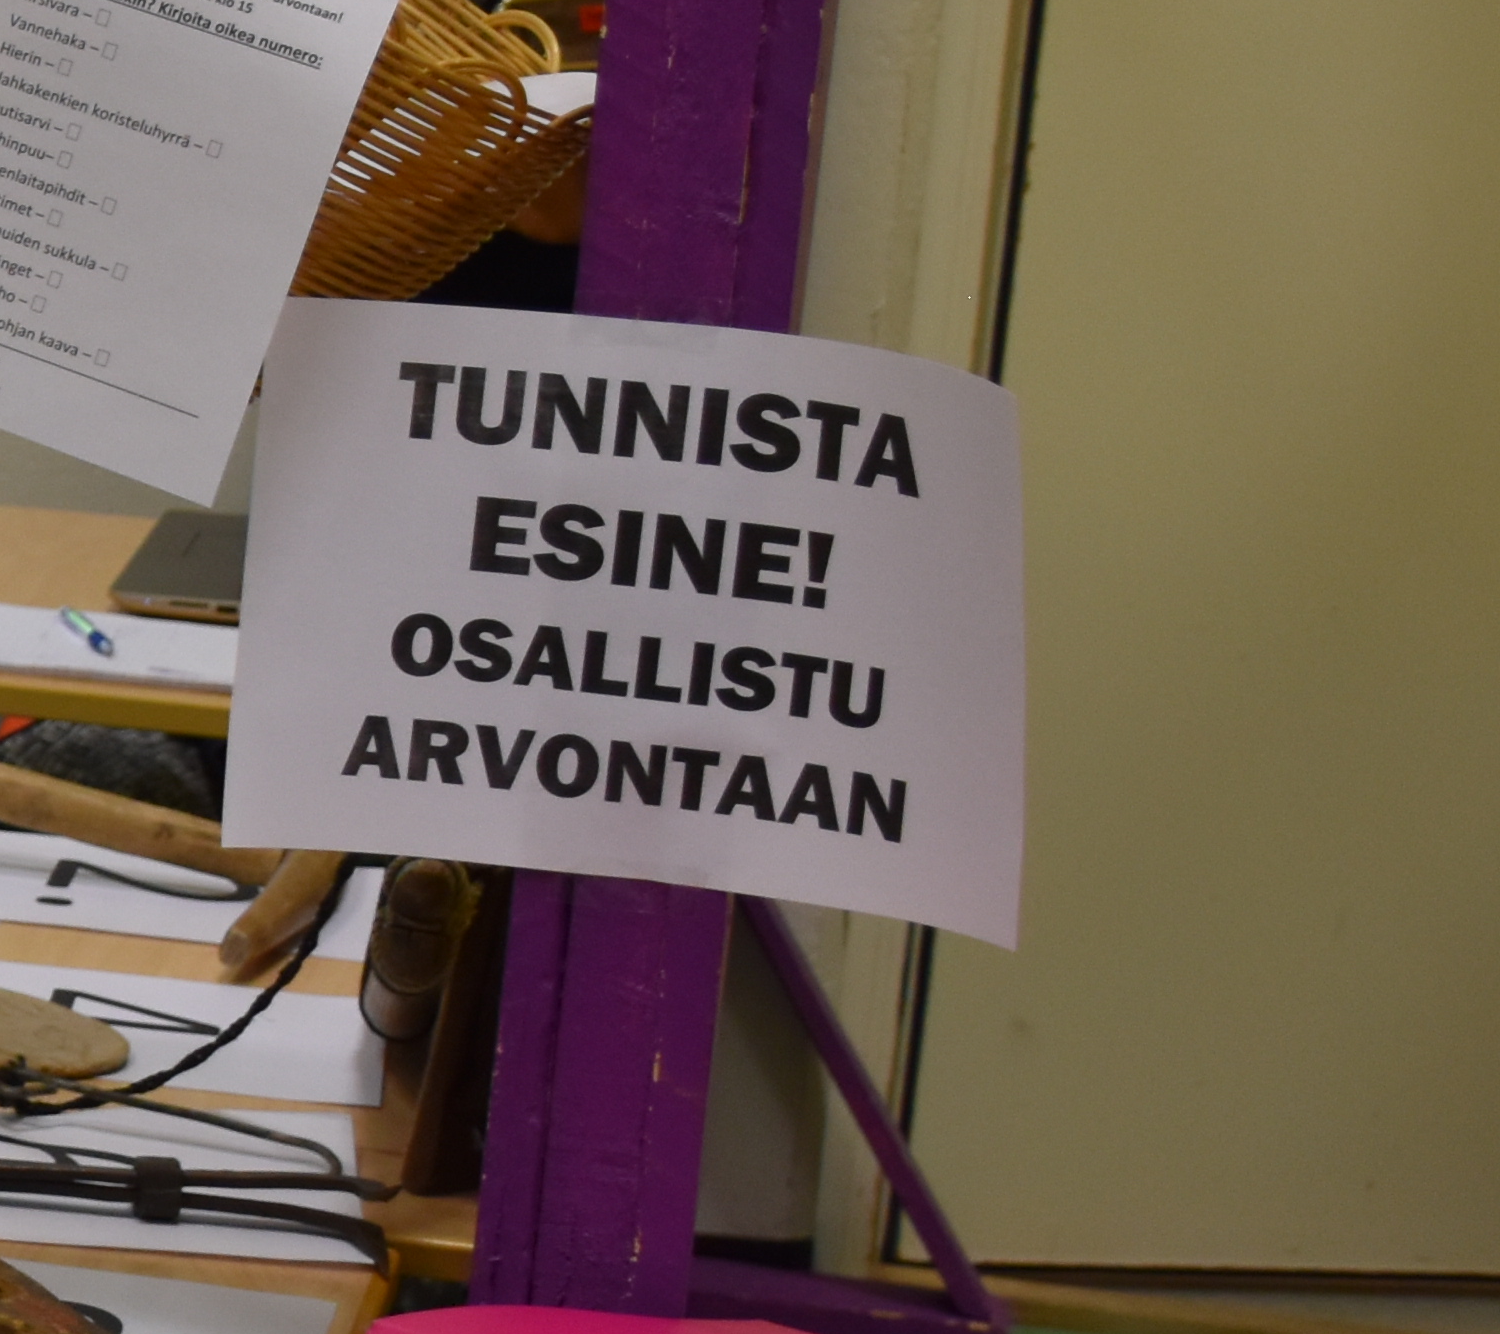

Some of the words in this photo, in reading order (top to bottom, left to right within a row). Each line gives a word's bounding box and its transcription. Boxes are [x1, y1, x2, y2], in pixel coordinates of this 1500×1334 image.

[10, 13, 86, 50] Vannehaka
[238, 0, 254, 14] 15
[0, 41, 42, 67] Hierin
[158, 0, 211, 31] Kirjoita
[214, 19, 256, 45] oikea
[258, 36, 324, 67] numero:
[91, 100, 191, 149] koristeluhyrrä
[43, 242, 97, 271] sukkula
[38, 331, 79, 357] kaava
[399, 360, 922, 499] TUNNISTA
[469, 496, 835, 610] ESINE!
[390, 612, 885, 730] OSALLISTU
[341, 715, 907, 844] ARVONTAAN
